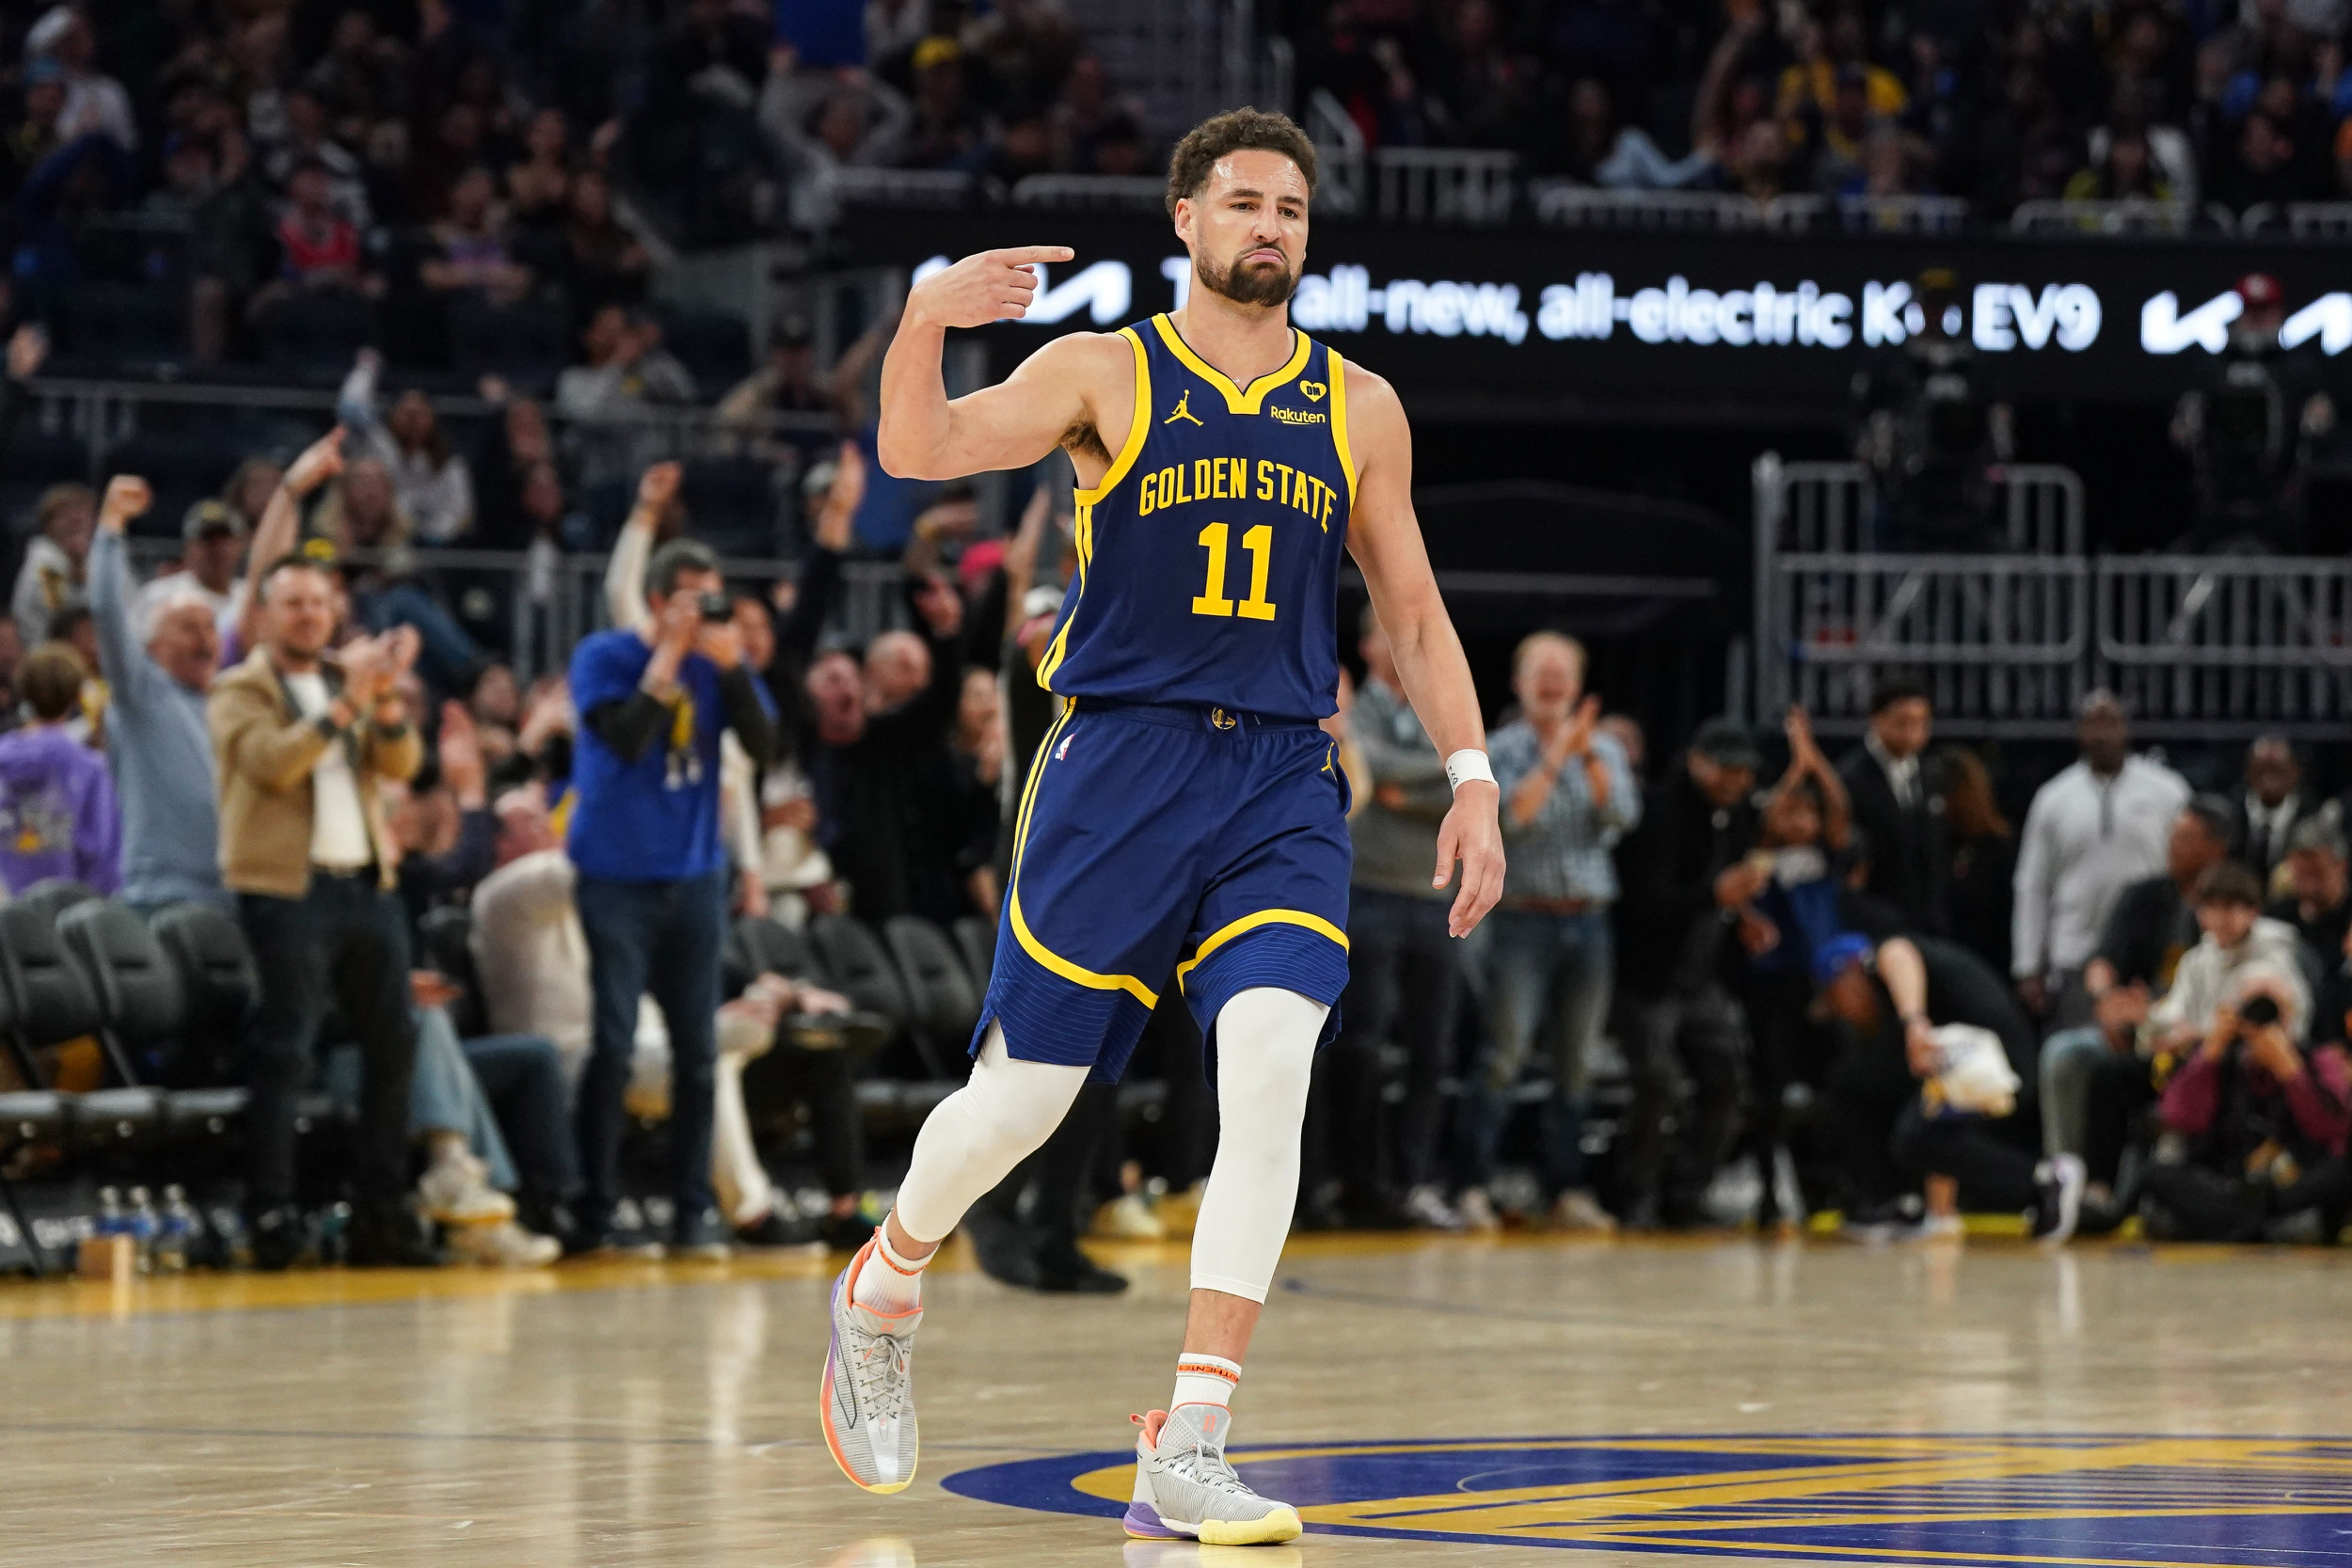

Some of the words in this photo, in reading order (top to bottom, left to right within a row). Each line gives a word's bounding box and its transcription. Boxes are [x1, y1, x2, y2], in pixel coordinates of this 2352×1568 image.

[1538, 271, 1852, 349] all-electric
[1973, 283, 2102, 351] EV9
[1270, 405, 1326, 424] Rakuten
[1138, 457, 1248, 517] GOLDEN
[1256, 459, 1338, 534] STATE
[1192, 521, 1277, 622] 11
